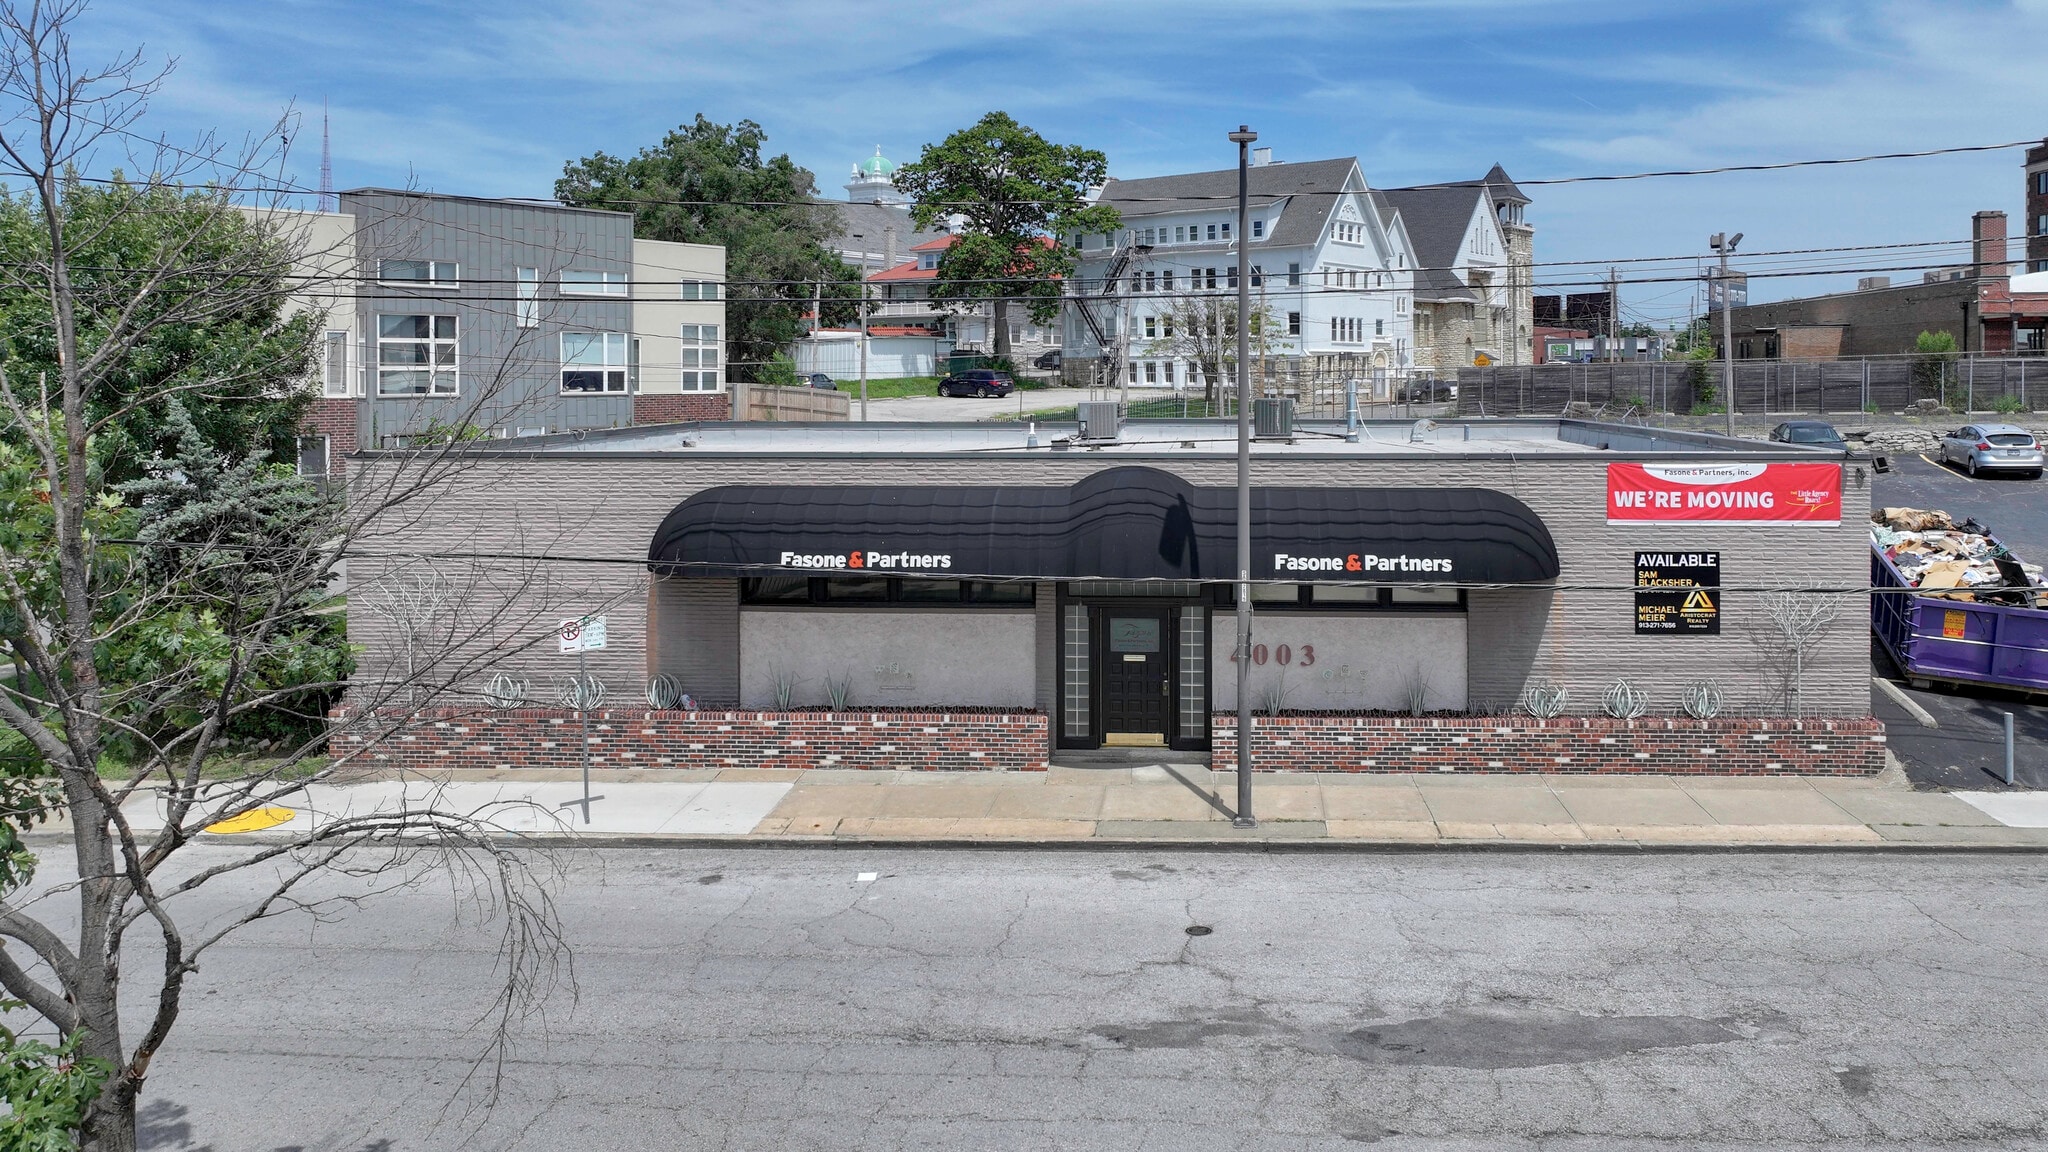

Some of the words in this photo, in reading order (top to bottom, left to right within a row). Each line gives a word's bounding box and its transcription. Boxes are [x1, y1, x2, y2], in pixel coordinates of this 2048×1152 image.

[1698, 469, 1735, 477] Partners,
[1614, 490, 1682, 508] WE’RE
[1687, 491, 1774, 508] MOVING
[780, 551, 847, 568] Fasone
[849, 551, 864, 569] &
[866, 551, 952, 568] Partners
[1274, 554, 1344, 571] Fasone
[1346, 553, 1362, 571] &
[1364, 554, 1453, 572] Partners
[1637, 554, 1717, 567] AVAILABLE
[1638, 570, 1658, 579] SAM
[1638, 578, 1693, 587] BLACKSHER
[1638, 605, 1678, 614] MICHAEL
[1638, 613, 1666, 622] MEIER
